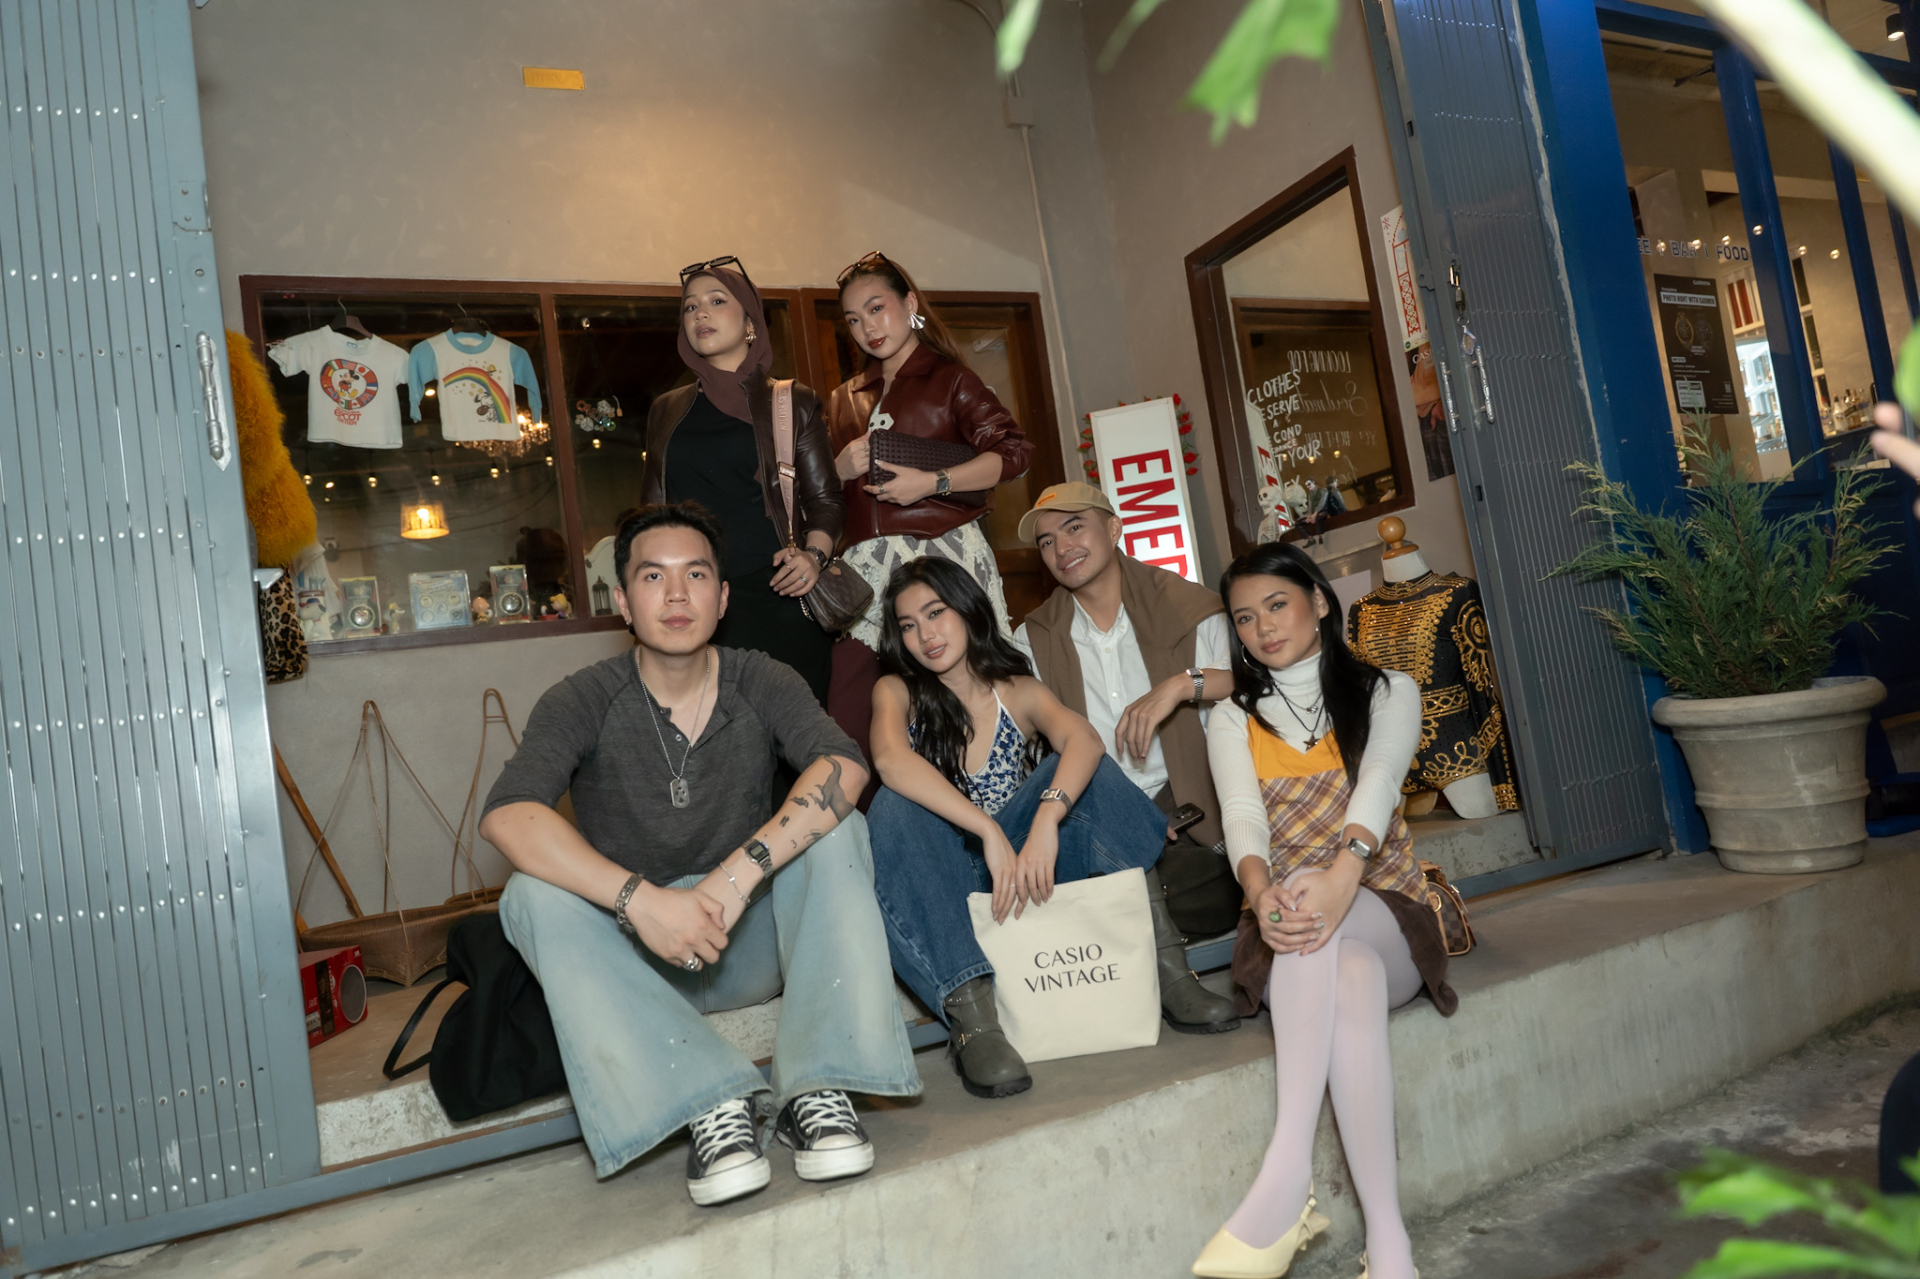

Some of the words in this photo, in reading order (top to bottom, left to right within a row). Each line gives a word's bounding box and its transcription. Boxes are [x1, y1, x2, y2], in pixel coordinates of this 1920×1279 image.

[1716, 245, 1749, 261] FOOD
[1247, 369, 1301, 405] CLOTHES
[1287, 439, 1322, 468] YOUR
[1034, 943, 1103, 969] CASIO
[1024, 963, 1121, 993] VINTAGE
